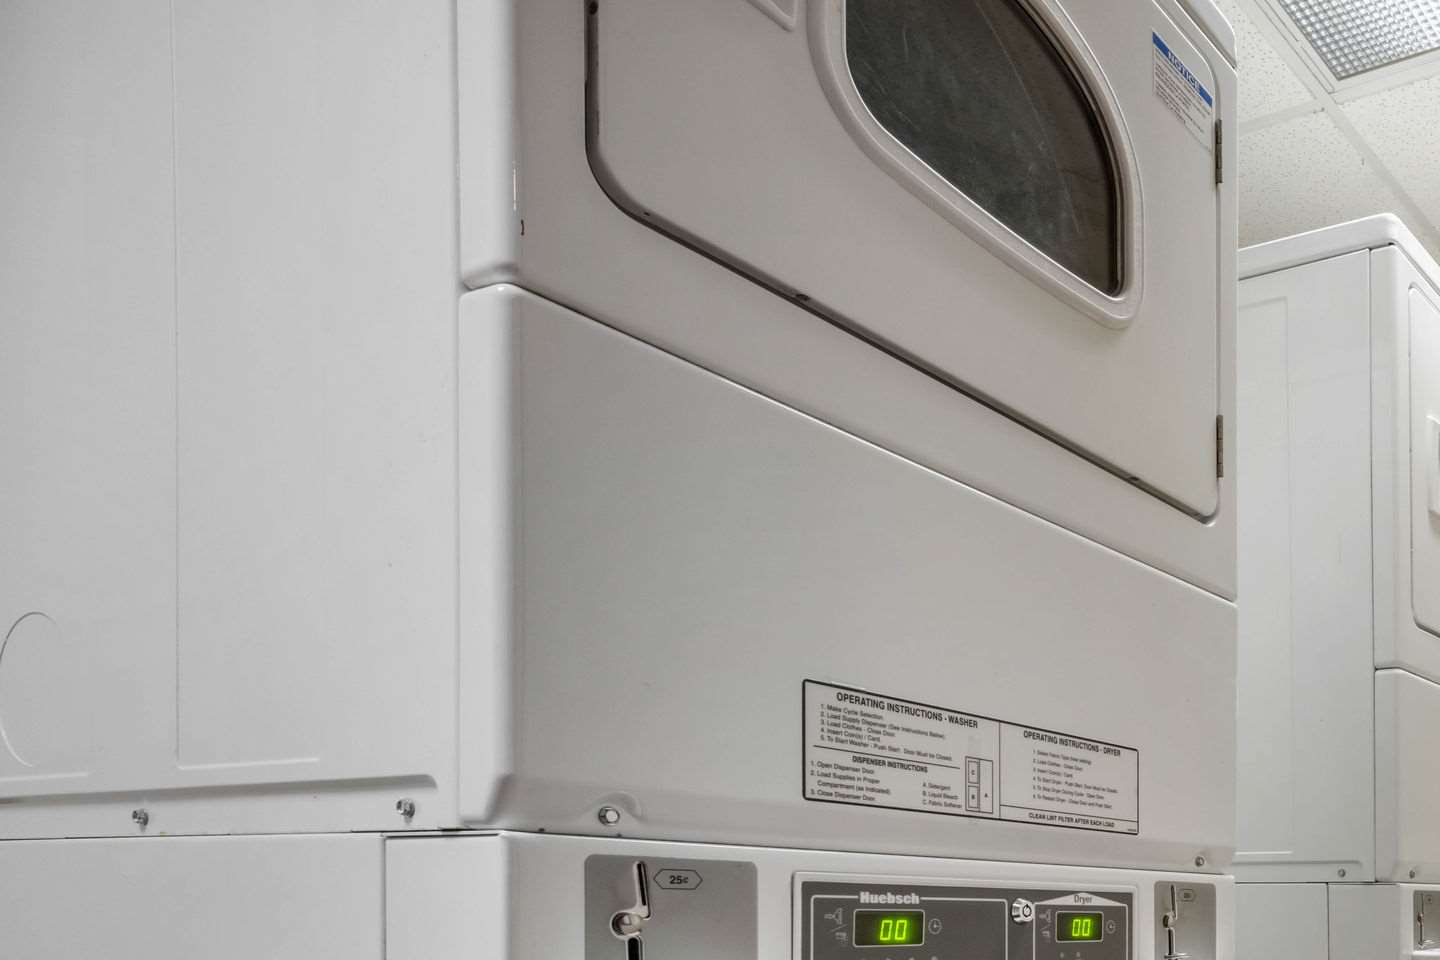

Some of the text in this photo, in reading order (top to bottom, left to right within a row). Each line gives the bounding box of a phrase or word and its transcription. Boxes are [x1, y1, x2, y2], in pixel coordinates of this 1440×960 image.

[836, 692, 885, 710] OPERATING
[886, 702, 943, 722] INSTRUCTIONS
[948, 714, 978, 729] WASHER
[1023, 730, 1058, 745] OPERATING
[1059, 738, 1100, 752] INSTRUCTIONS
[1103, 746, 1121, 757] DRYER
[852, 755, 928, 773] DISPENSER INSTRUCTIONS
[1028, 812, 1046, 820] CLEAR
[1057, 815, 1074, 824] FILTER
[860, 890, 920, 905] Huebsch
[1073, 894, 1093, 905] Dryer
[879, 919, 908, 941] 00
[1071, 918, 1091, 937] 00
